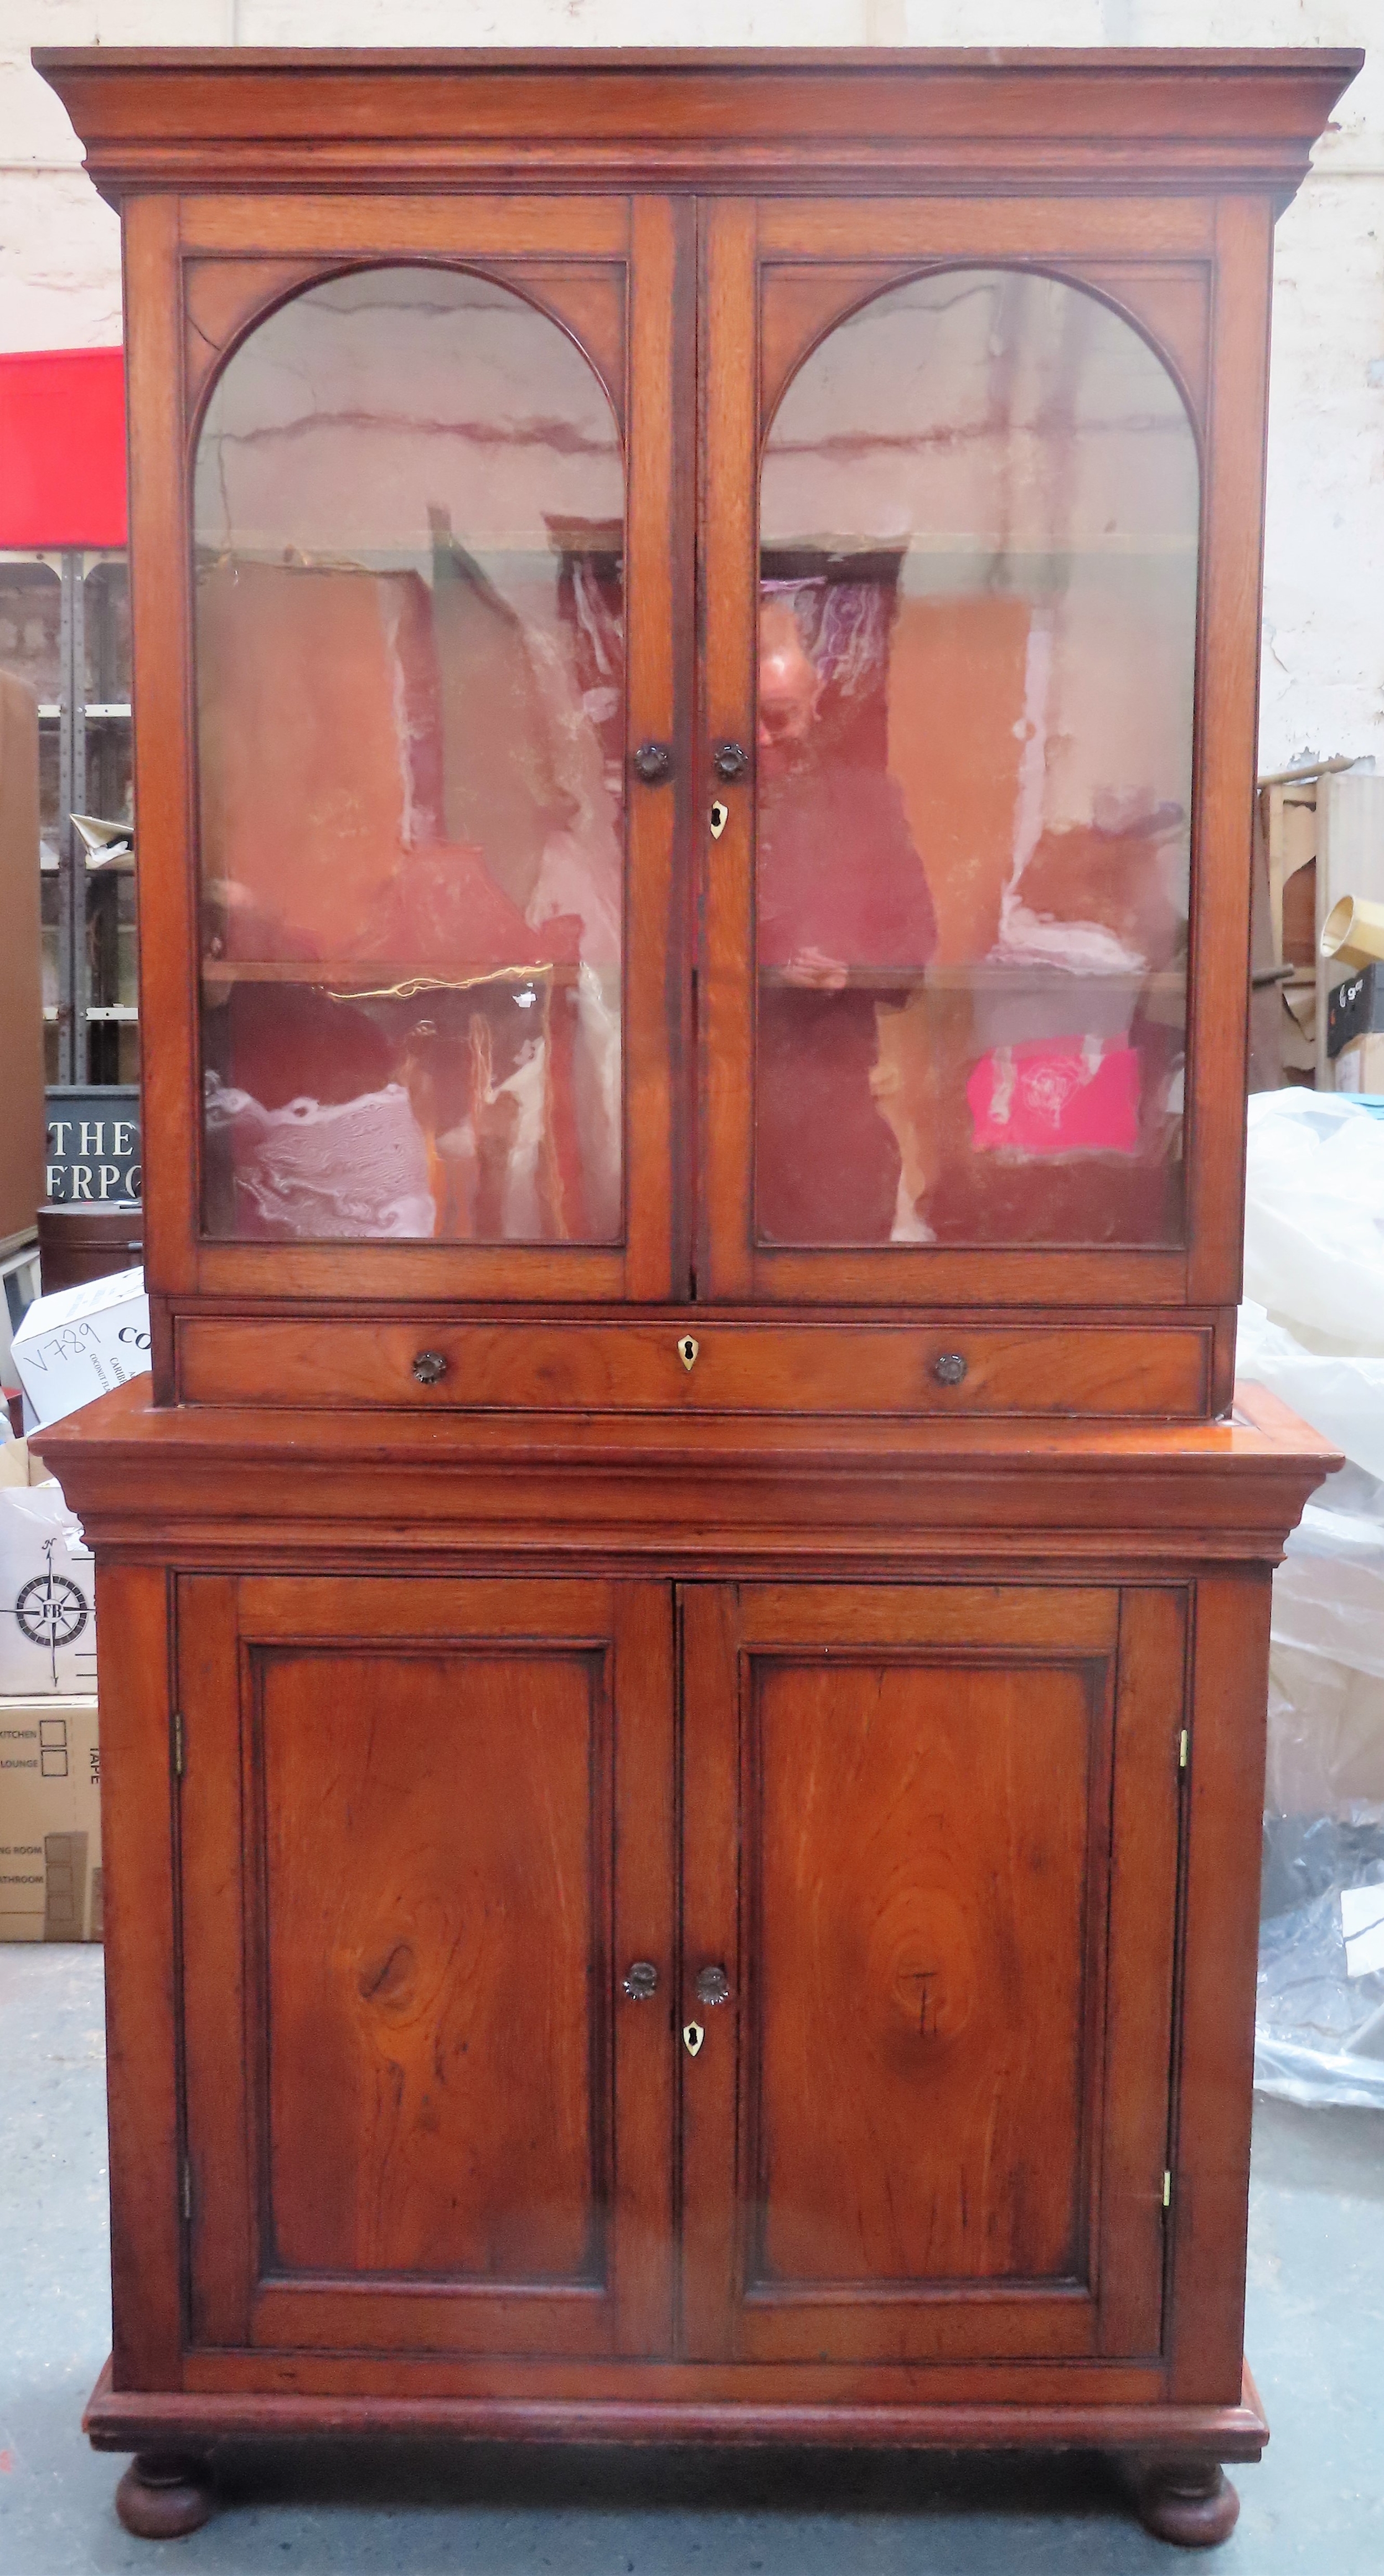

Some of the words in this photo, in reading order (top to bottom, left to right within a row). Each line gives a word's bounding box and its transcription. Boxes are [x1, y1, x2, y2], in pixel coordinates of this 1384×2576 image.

[48, 1121, 136, 1156] THE
[23, 1323, 101, 1371] V789
[118, 1327, 151, 1349] CO
[90, 1353, 107, 1380] COCONUT
[43, 1604, 62, 1618] FB
[1, 1760, 38, 1768] LOUNGE
[13, 1846, 42, 1855] ROOM
